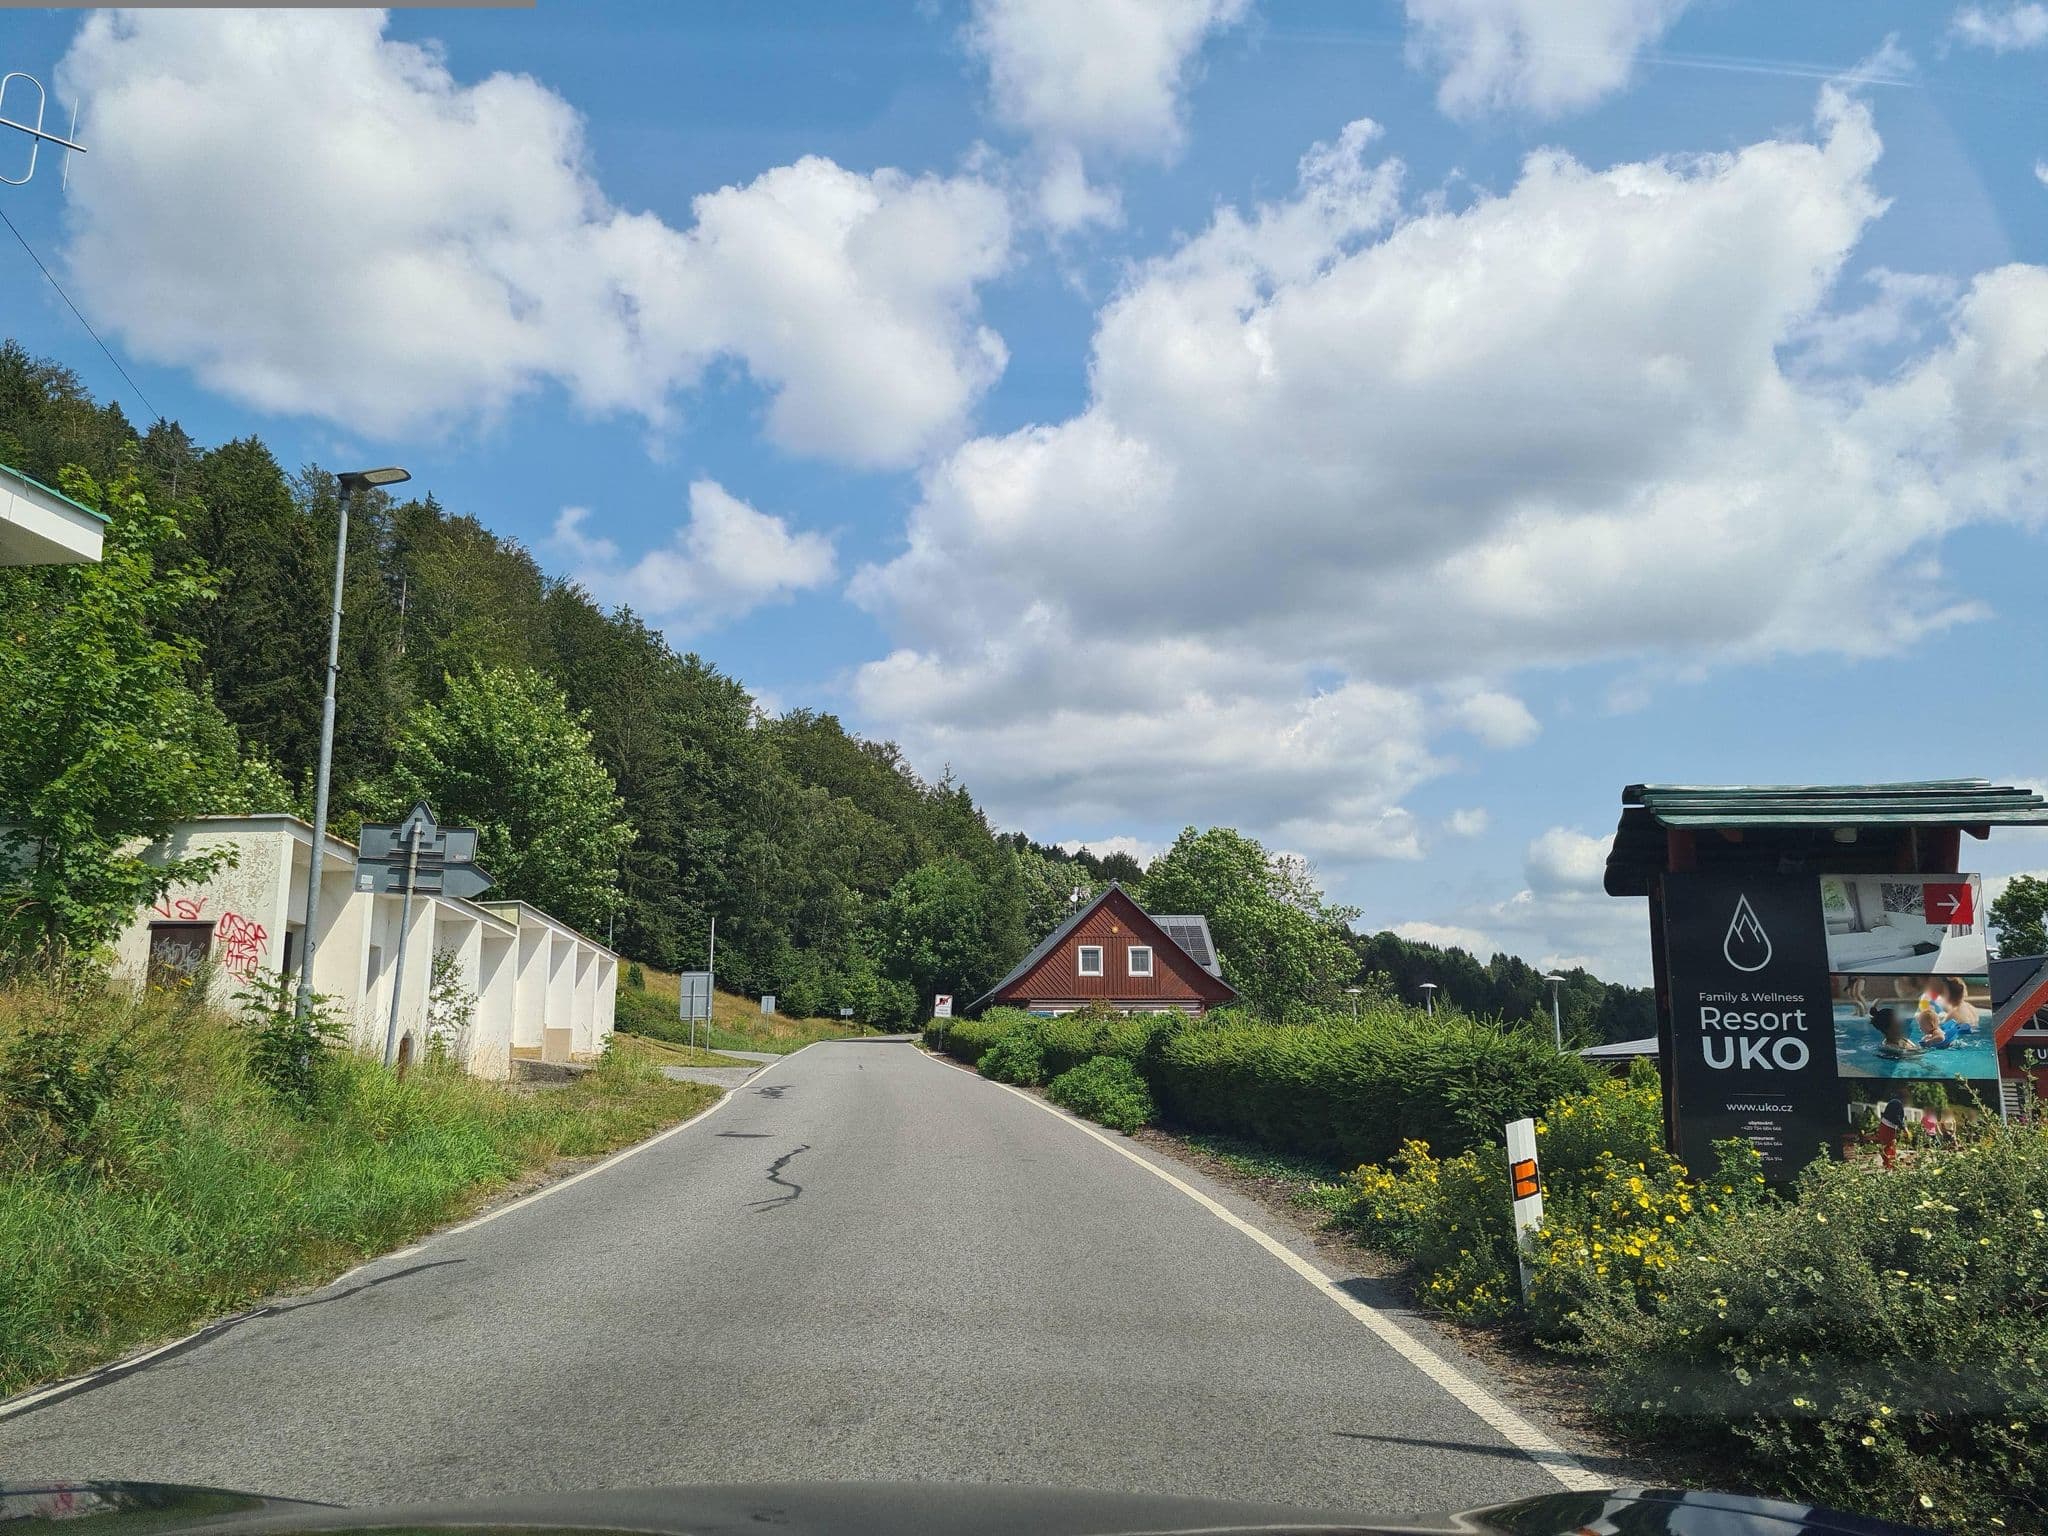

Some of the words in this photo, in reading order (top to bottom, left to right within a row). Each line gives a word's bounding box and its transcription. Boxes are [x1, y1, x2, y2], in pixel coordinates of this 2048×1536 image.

[1699, 992, 1738, 1003] Family
[1741, 993, 1749, 1002] &
[1752, 993, 1805, 1002] Wellness
[1700, 1006, 1809, 1031] Resort
[1702, 1036, 1810, 1071] UKO
[1726, 1103, 1793, 1112] www.uko.cz
